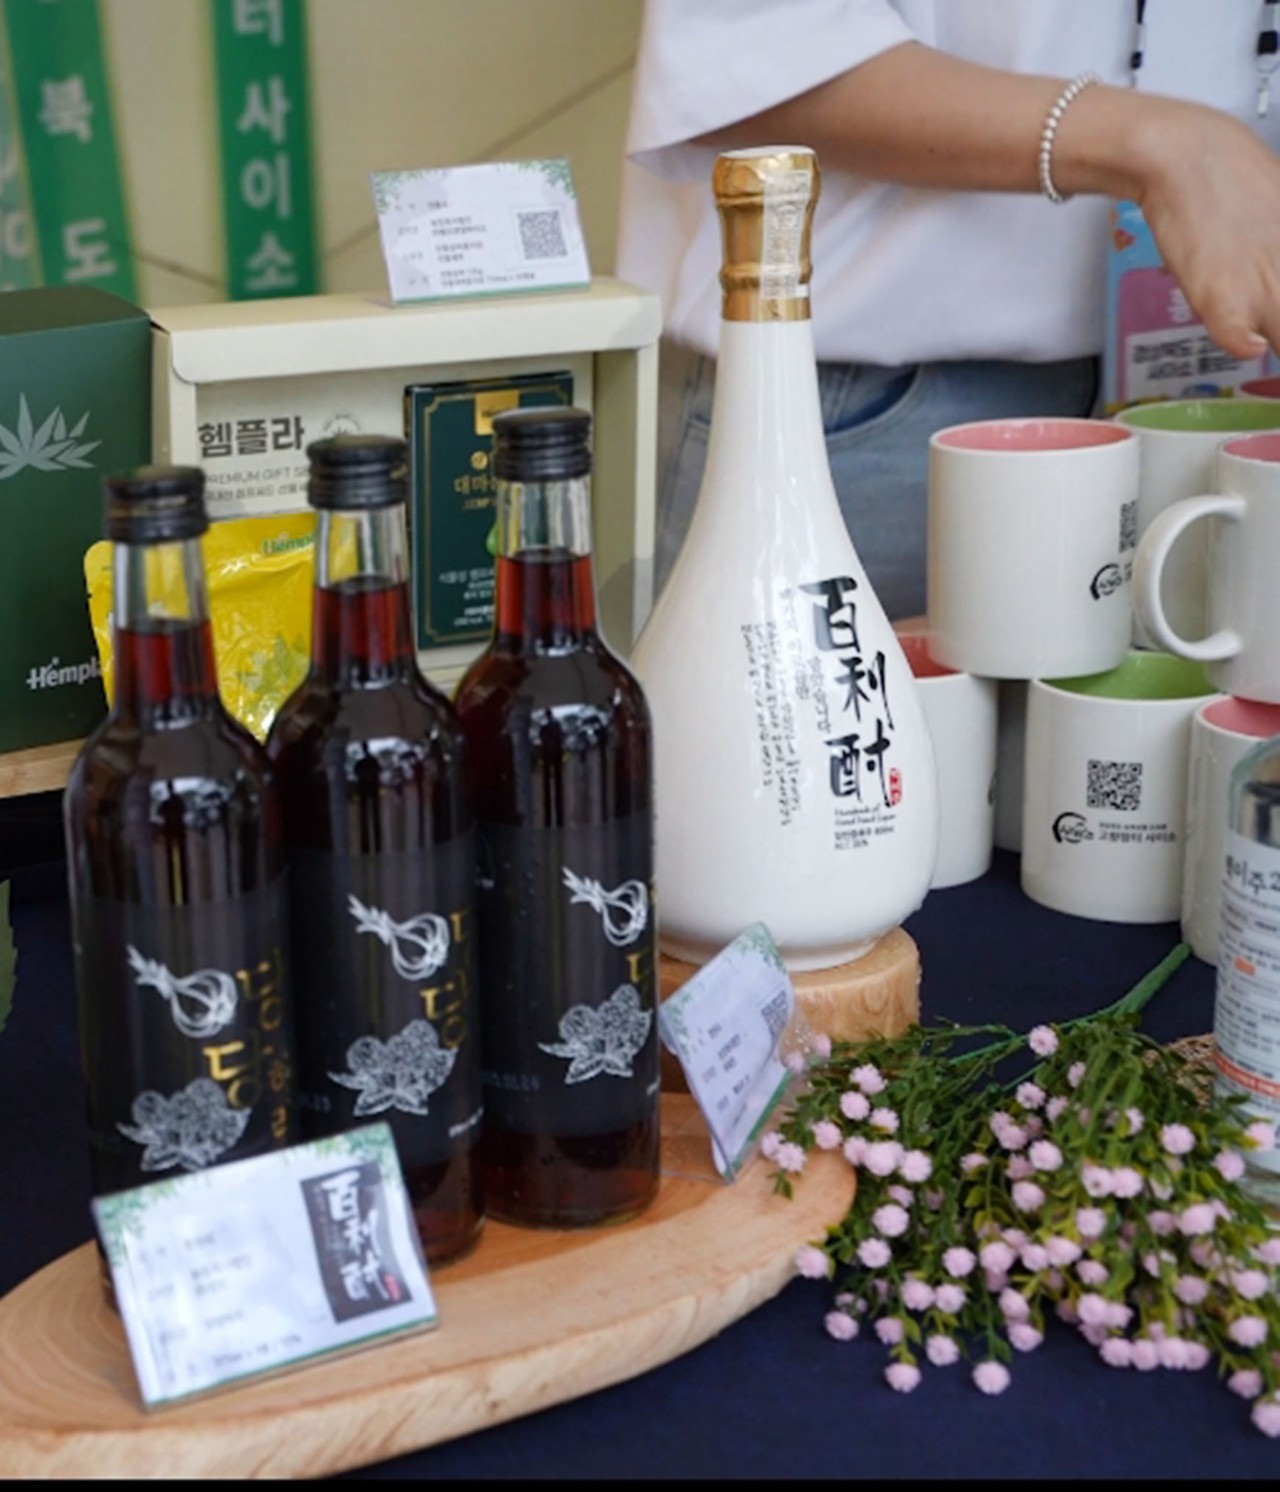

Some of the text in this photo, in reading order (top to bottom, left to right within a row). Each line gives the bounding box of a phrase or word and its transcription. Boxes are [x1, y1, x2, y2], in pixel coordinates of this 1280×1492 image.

[39, 73, 117, 284] 북도
[237, 75, 298, 292] 사이소
[198, 416, 306, 458] 헴플라
